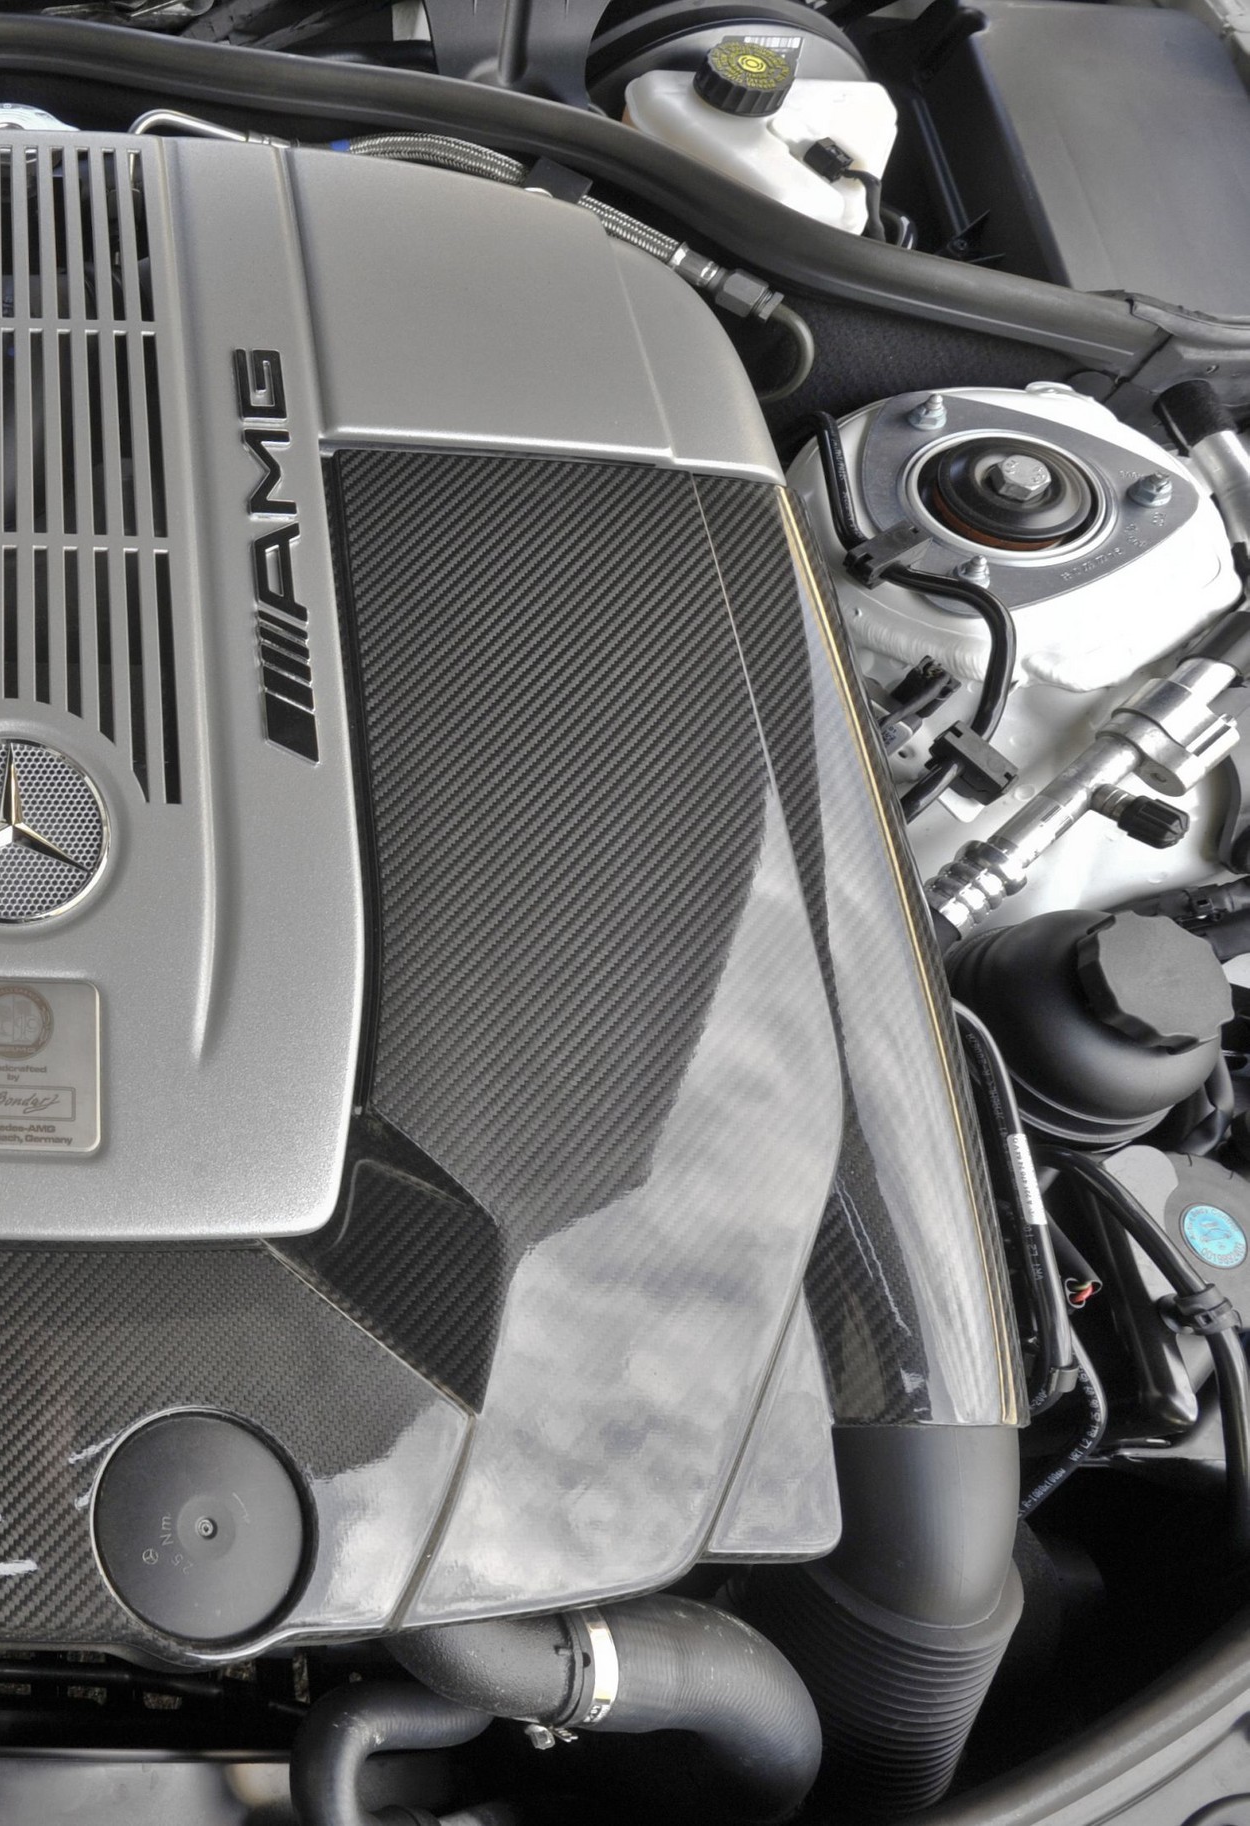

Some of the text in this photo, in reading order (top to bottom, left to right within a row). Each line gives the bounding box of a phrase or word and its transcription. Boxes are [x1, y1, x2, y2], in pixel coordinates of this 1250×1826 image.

[233, 348, 308, 622] AMG
[6, 1074, 20, 1082] by
[24, 1134, 73, 1146] Germany
[160, 1515, 174, 1547] Nm
